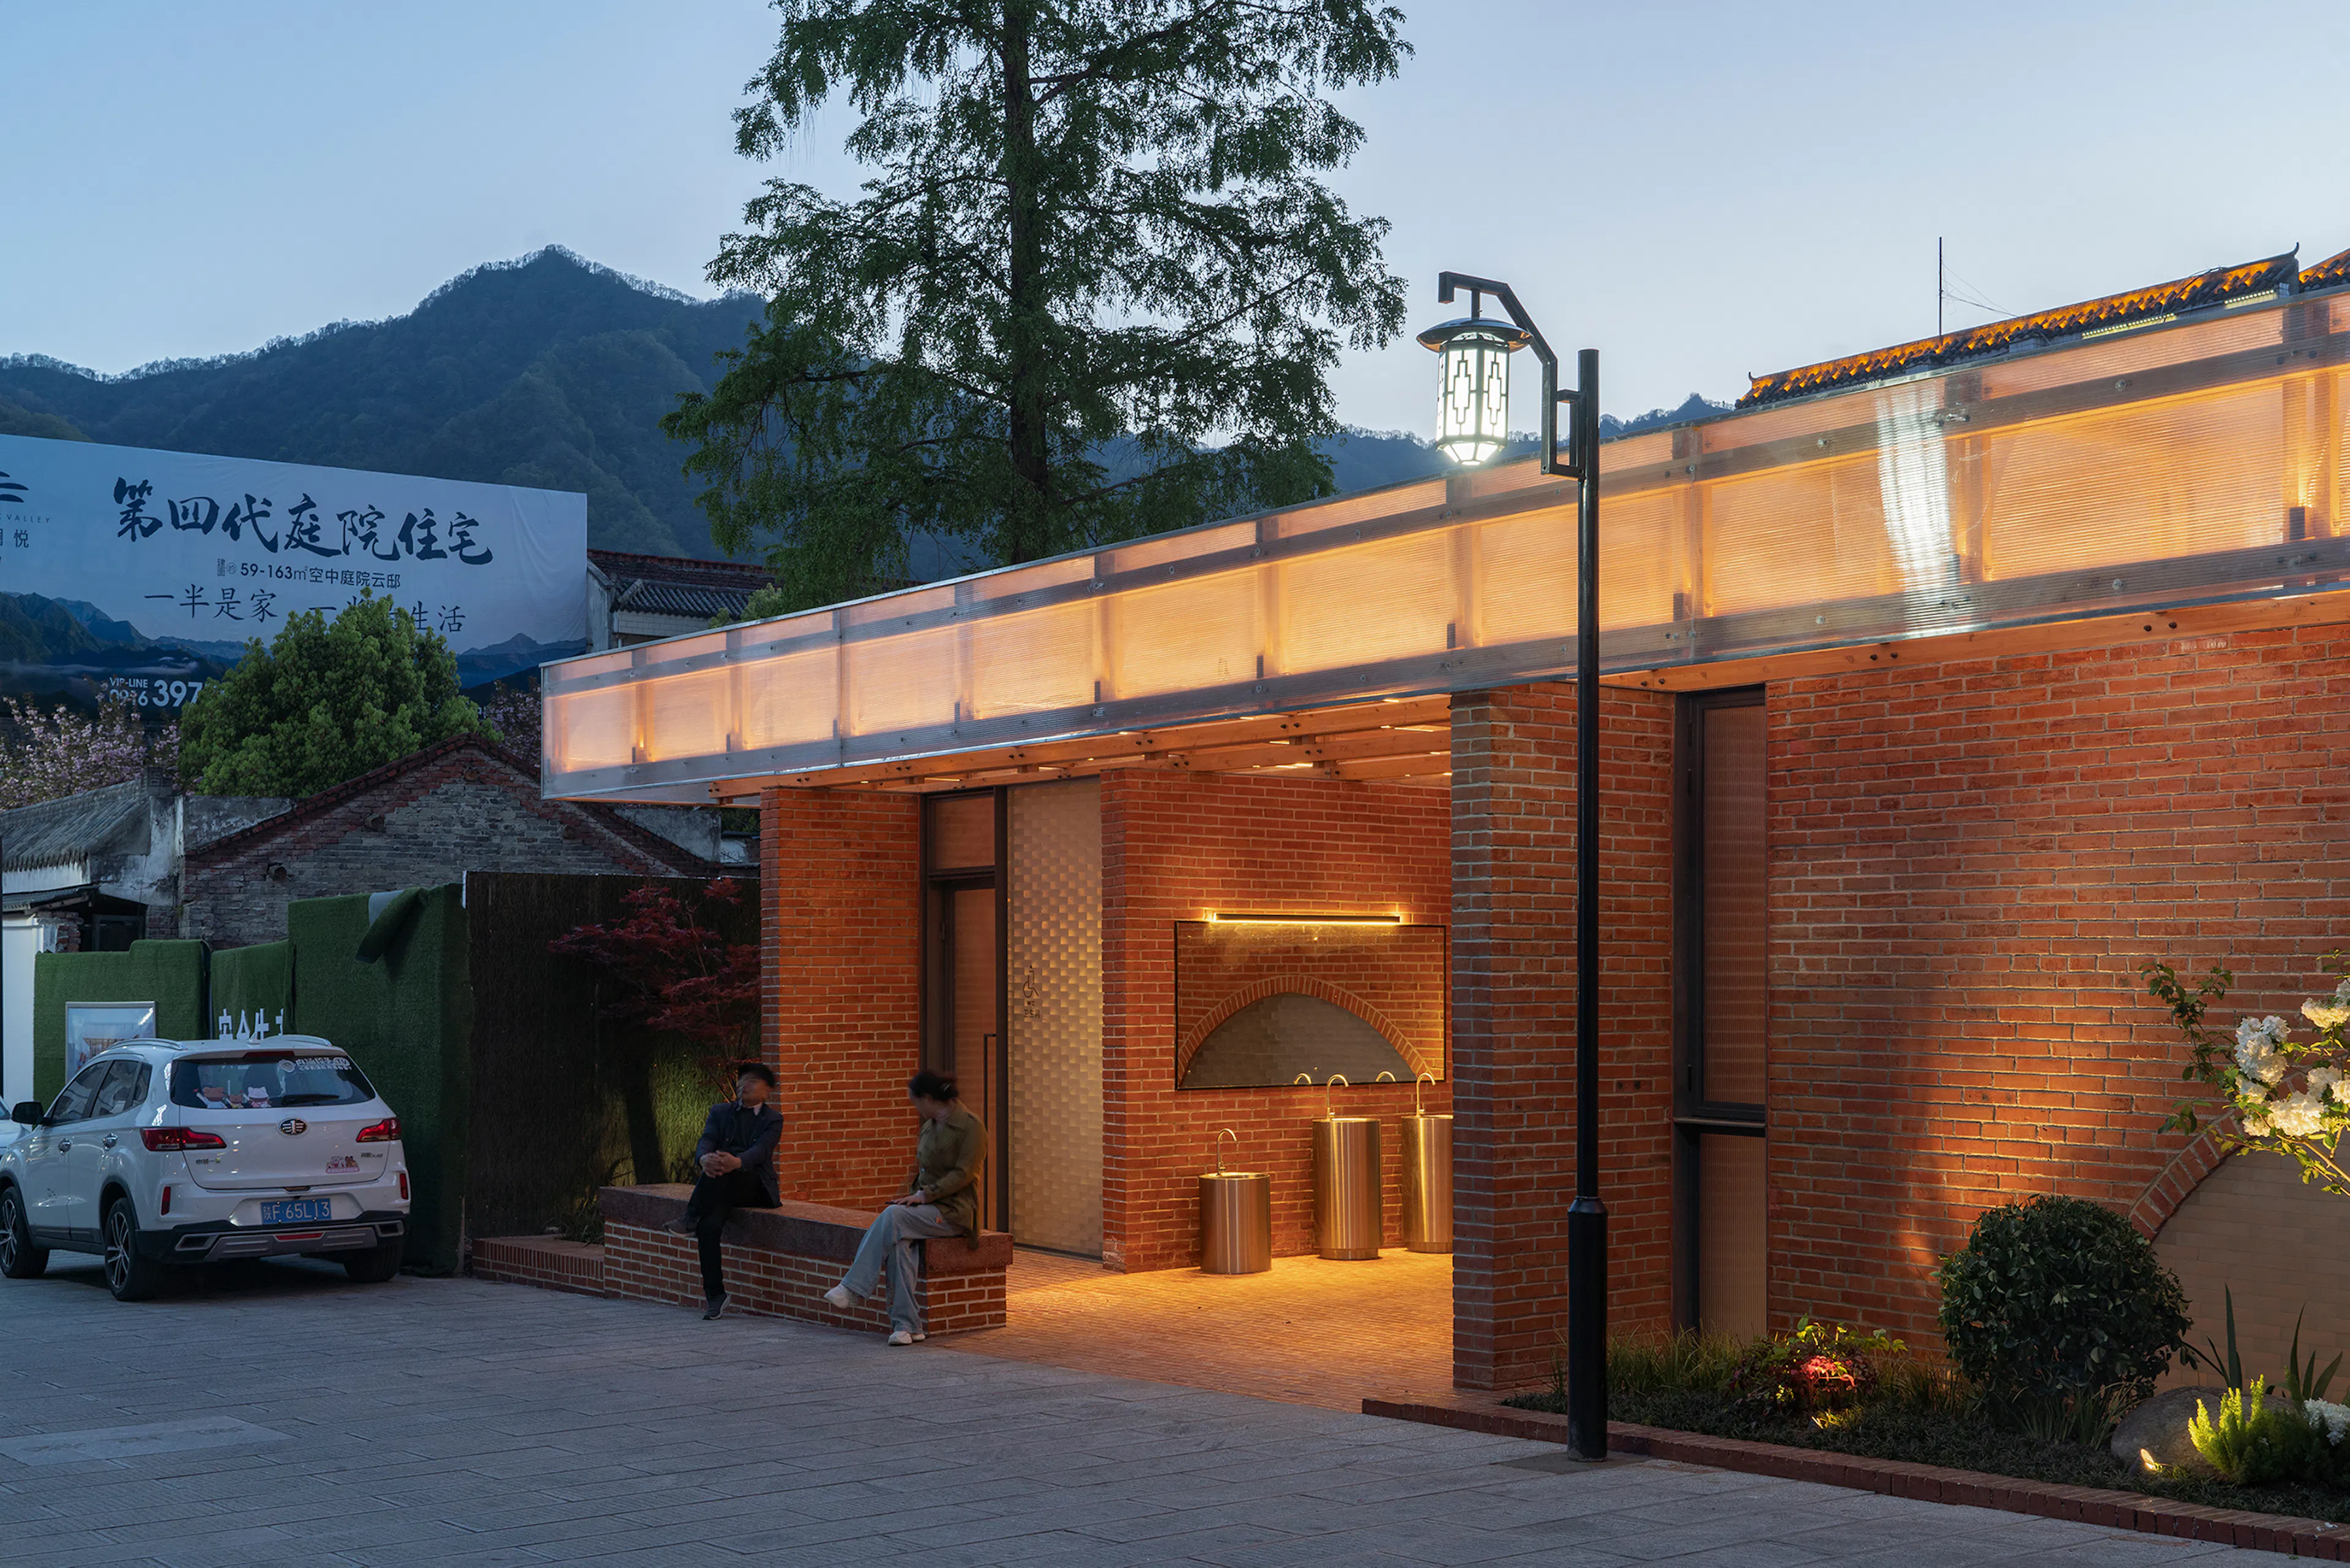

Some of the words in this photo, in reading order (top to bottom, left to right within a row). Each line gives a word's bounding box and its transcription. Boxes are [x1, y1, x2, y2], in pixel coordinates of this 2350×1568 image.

[6, 513, 50, 523] VALLEY
[113, 476, 493, 565] 第四代庭院住宅
[144, 583, 278, 623] 一半是家
[308, 595, 466, 633] 一生活
[109, 677, 148, 689] VIP-LINE
